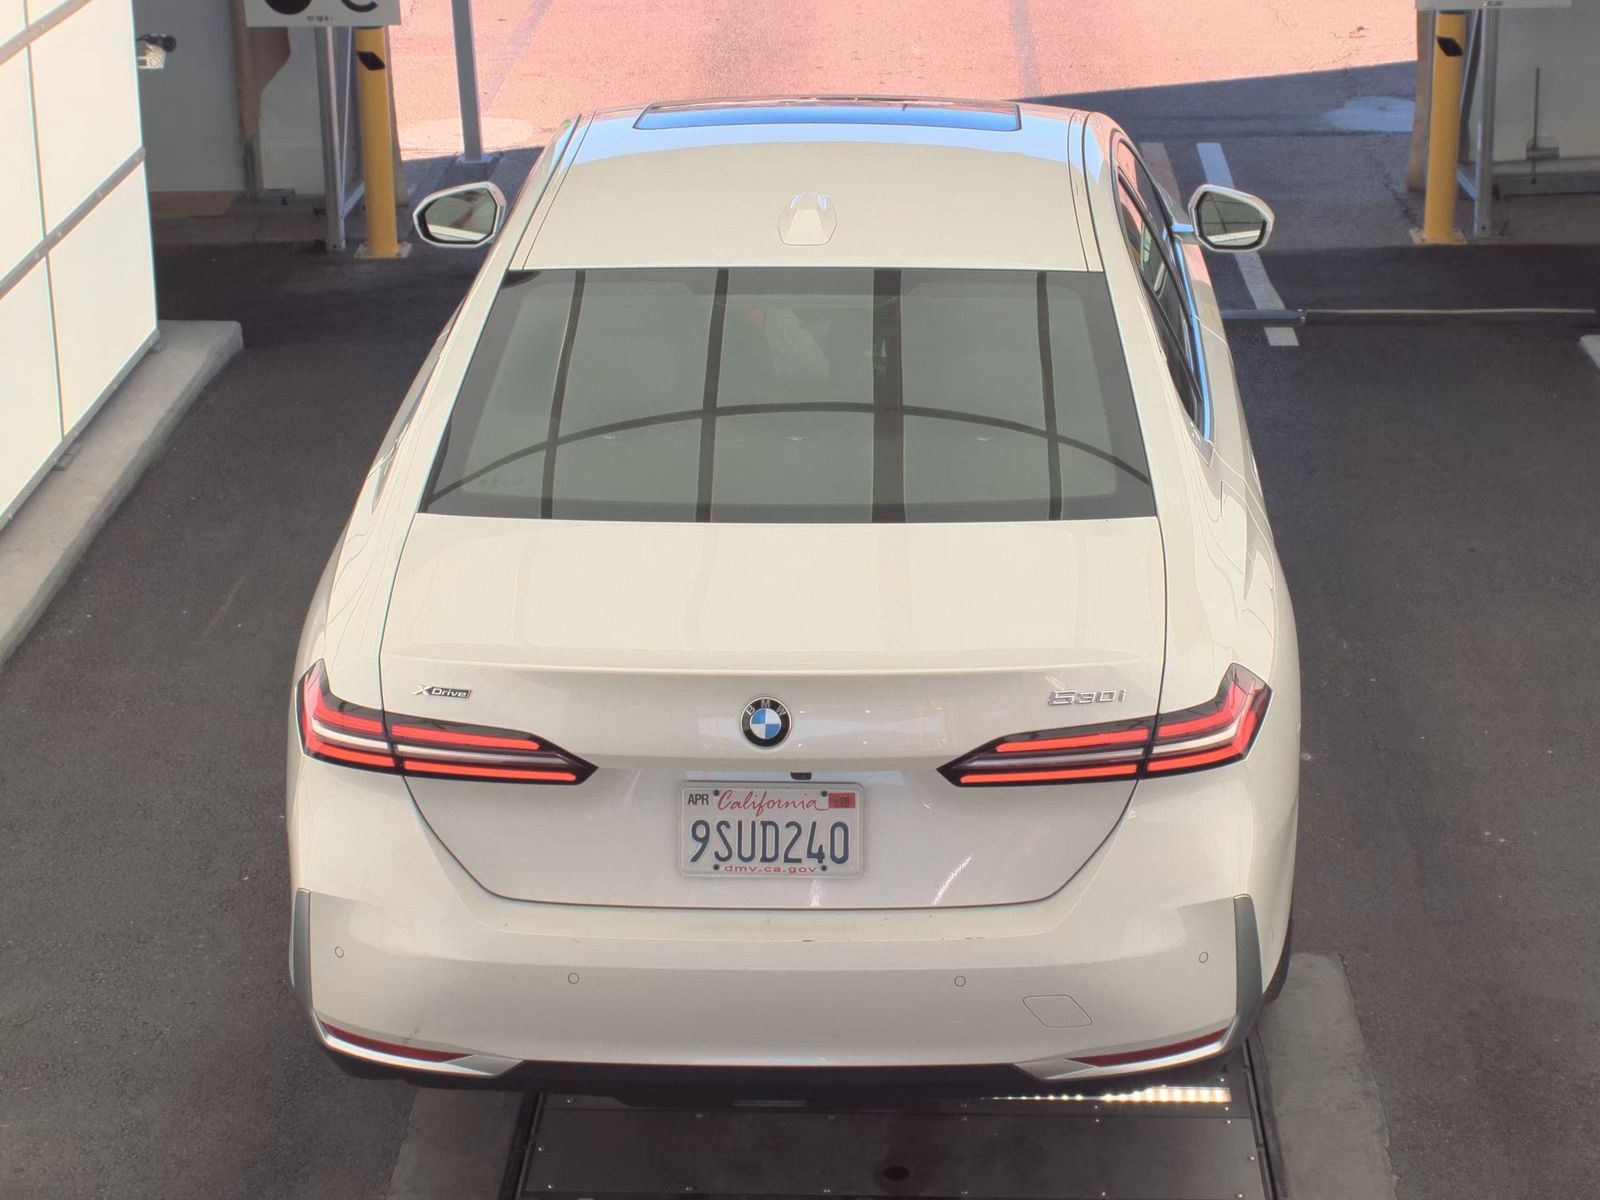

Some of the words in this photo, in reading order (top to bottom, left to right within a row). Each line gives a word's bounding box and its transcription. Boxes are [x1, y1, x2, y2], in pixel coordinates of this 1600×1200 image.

[687, 793, 709, 806] APR
[717, 789, 829, 817] California
[690, 819, 849, 865] 9SUD240
[724, 864, 817, 874] dmv.ca.gov
